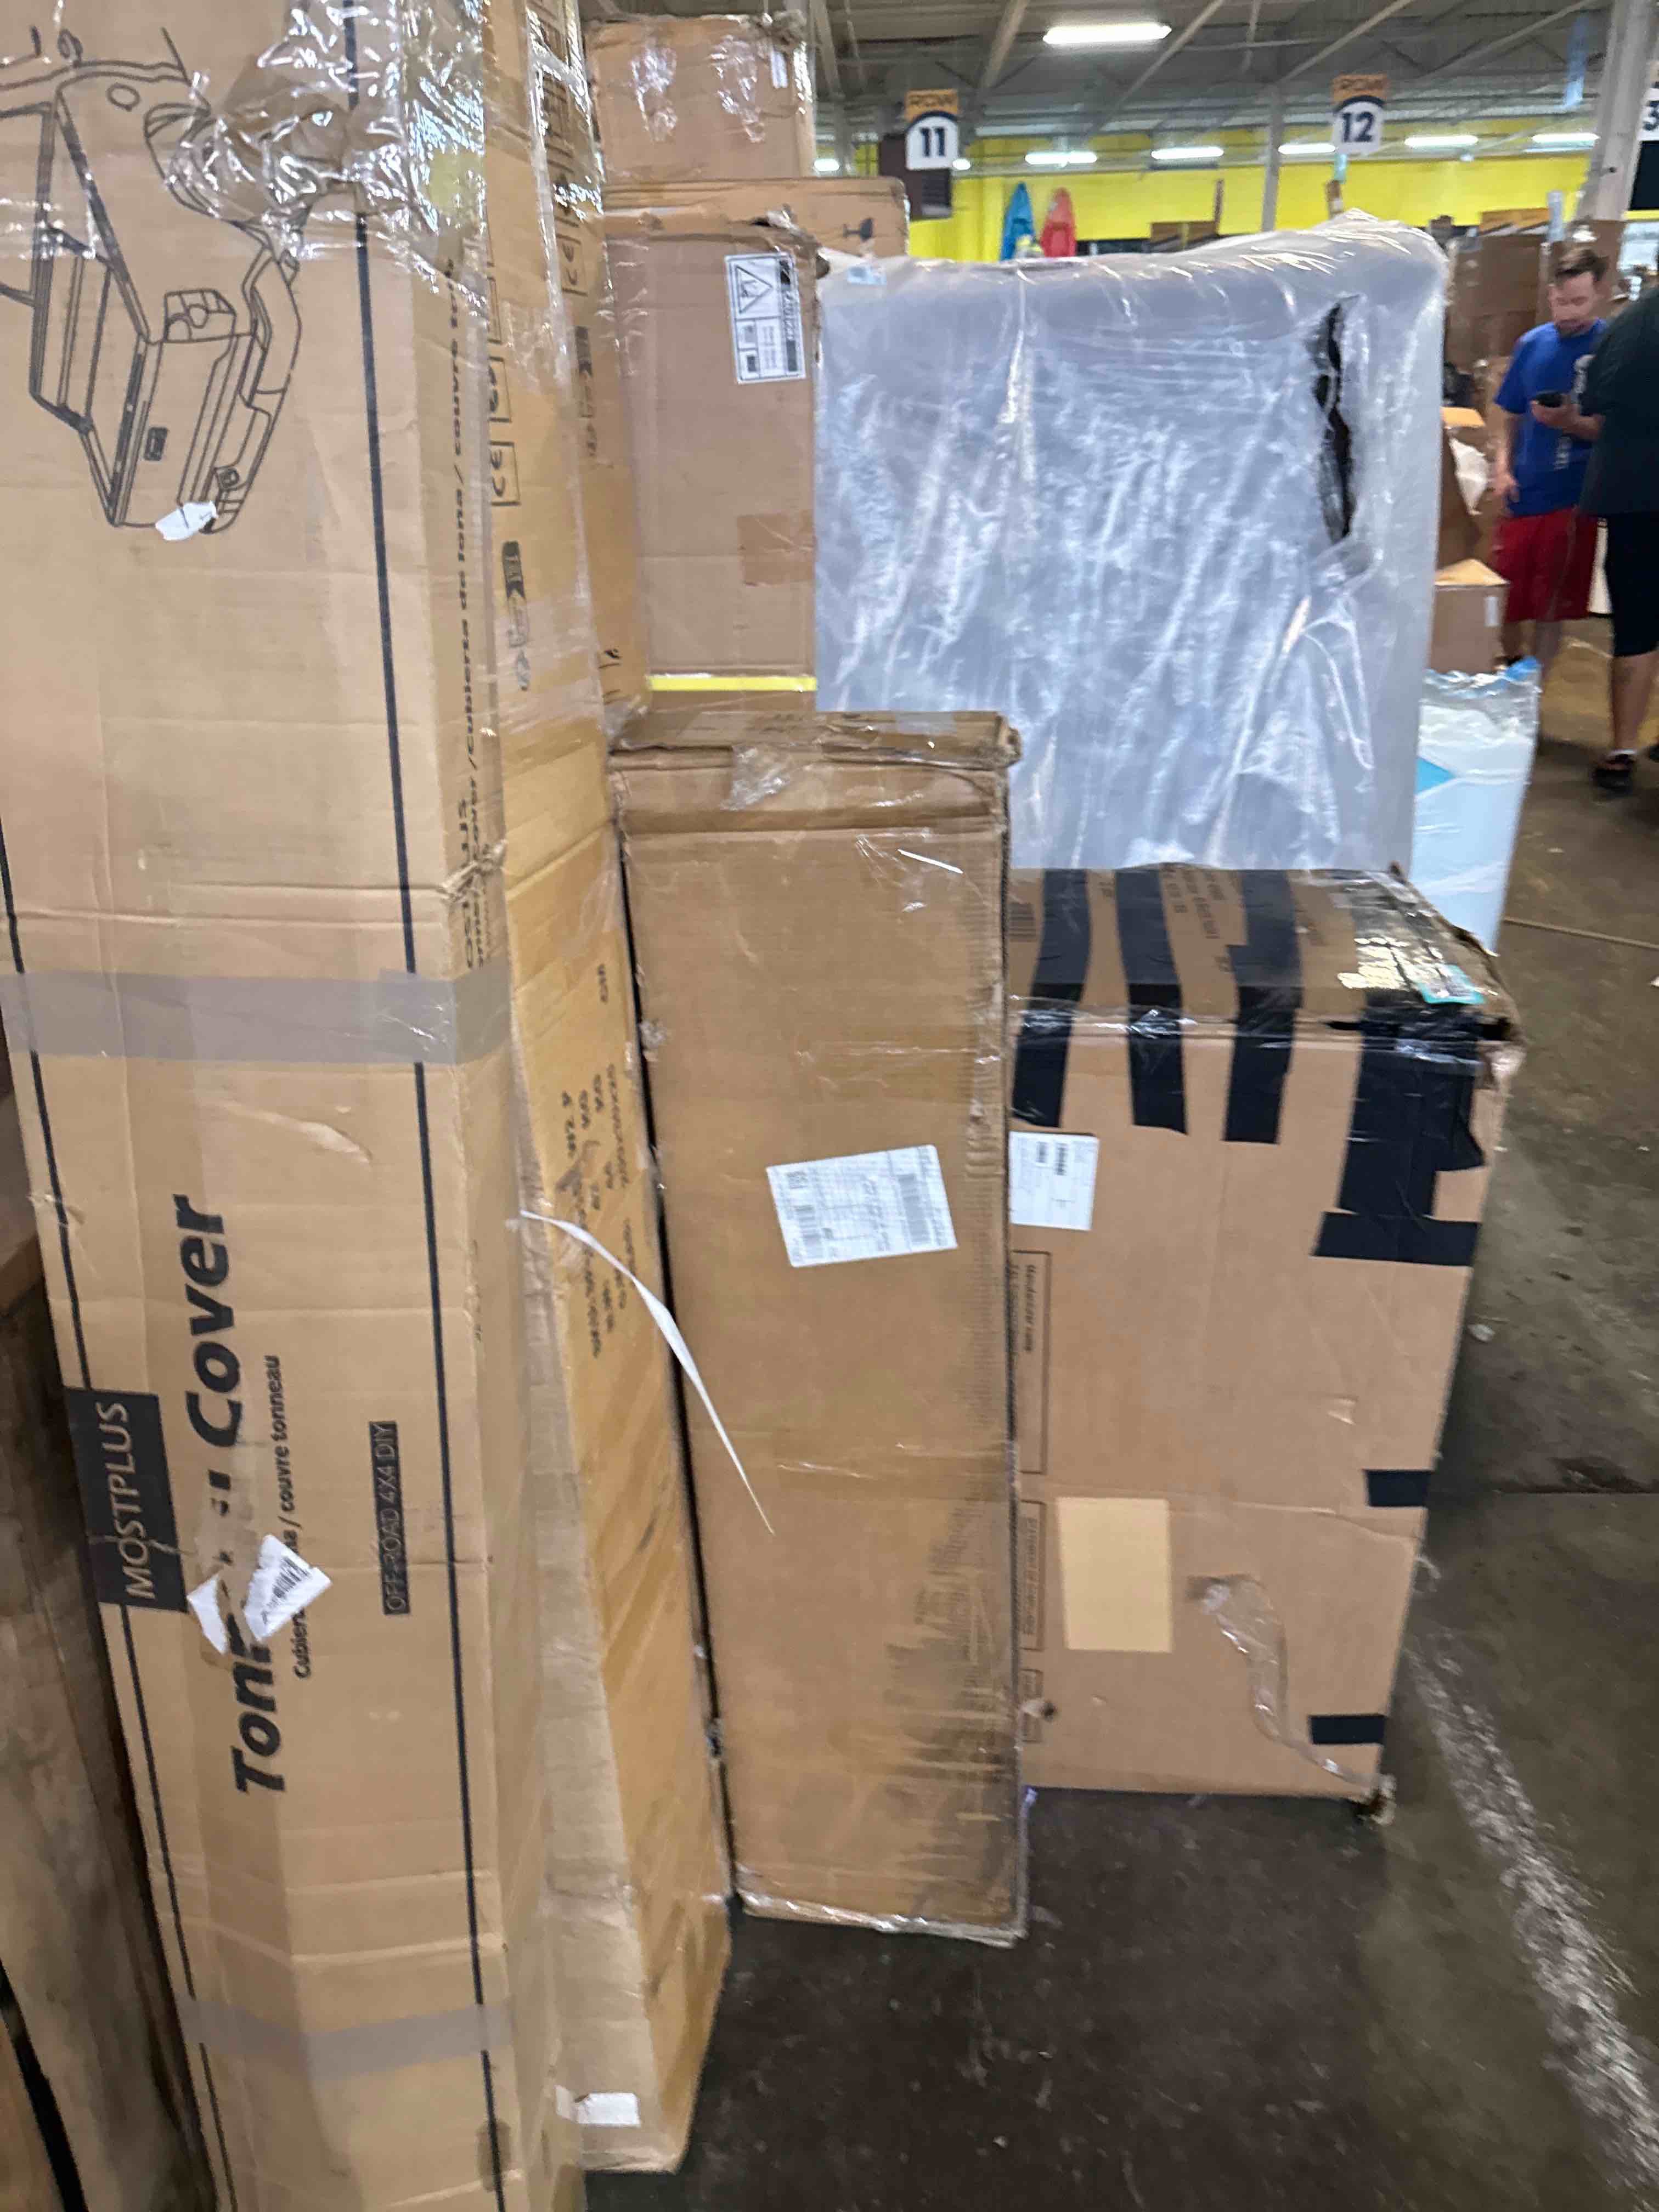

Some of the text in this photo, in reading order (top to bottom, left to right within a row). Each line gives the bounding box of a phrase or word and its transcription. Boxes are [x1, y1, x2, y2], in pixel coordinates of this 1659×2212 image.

[920, 127, 945, 157] 11
[1342, 111, 1375, 142] 12
[173, 1193, 244, 1448] Cover
[264, 1355, 288, 1443] tonneau
[373, 1424, 396, 1460] DIY
[95, 1402, 156, 1599] MOSTPLUS
[274, 1446, 295, 1513] couvre
